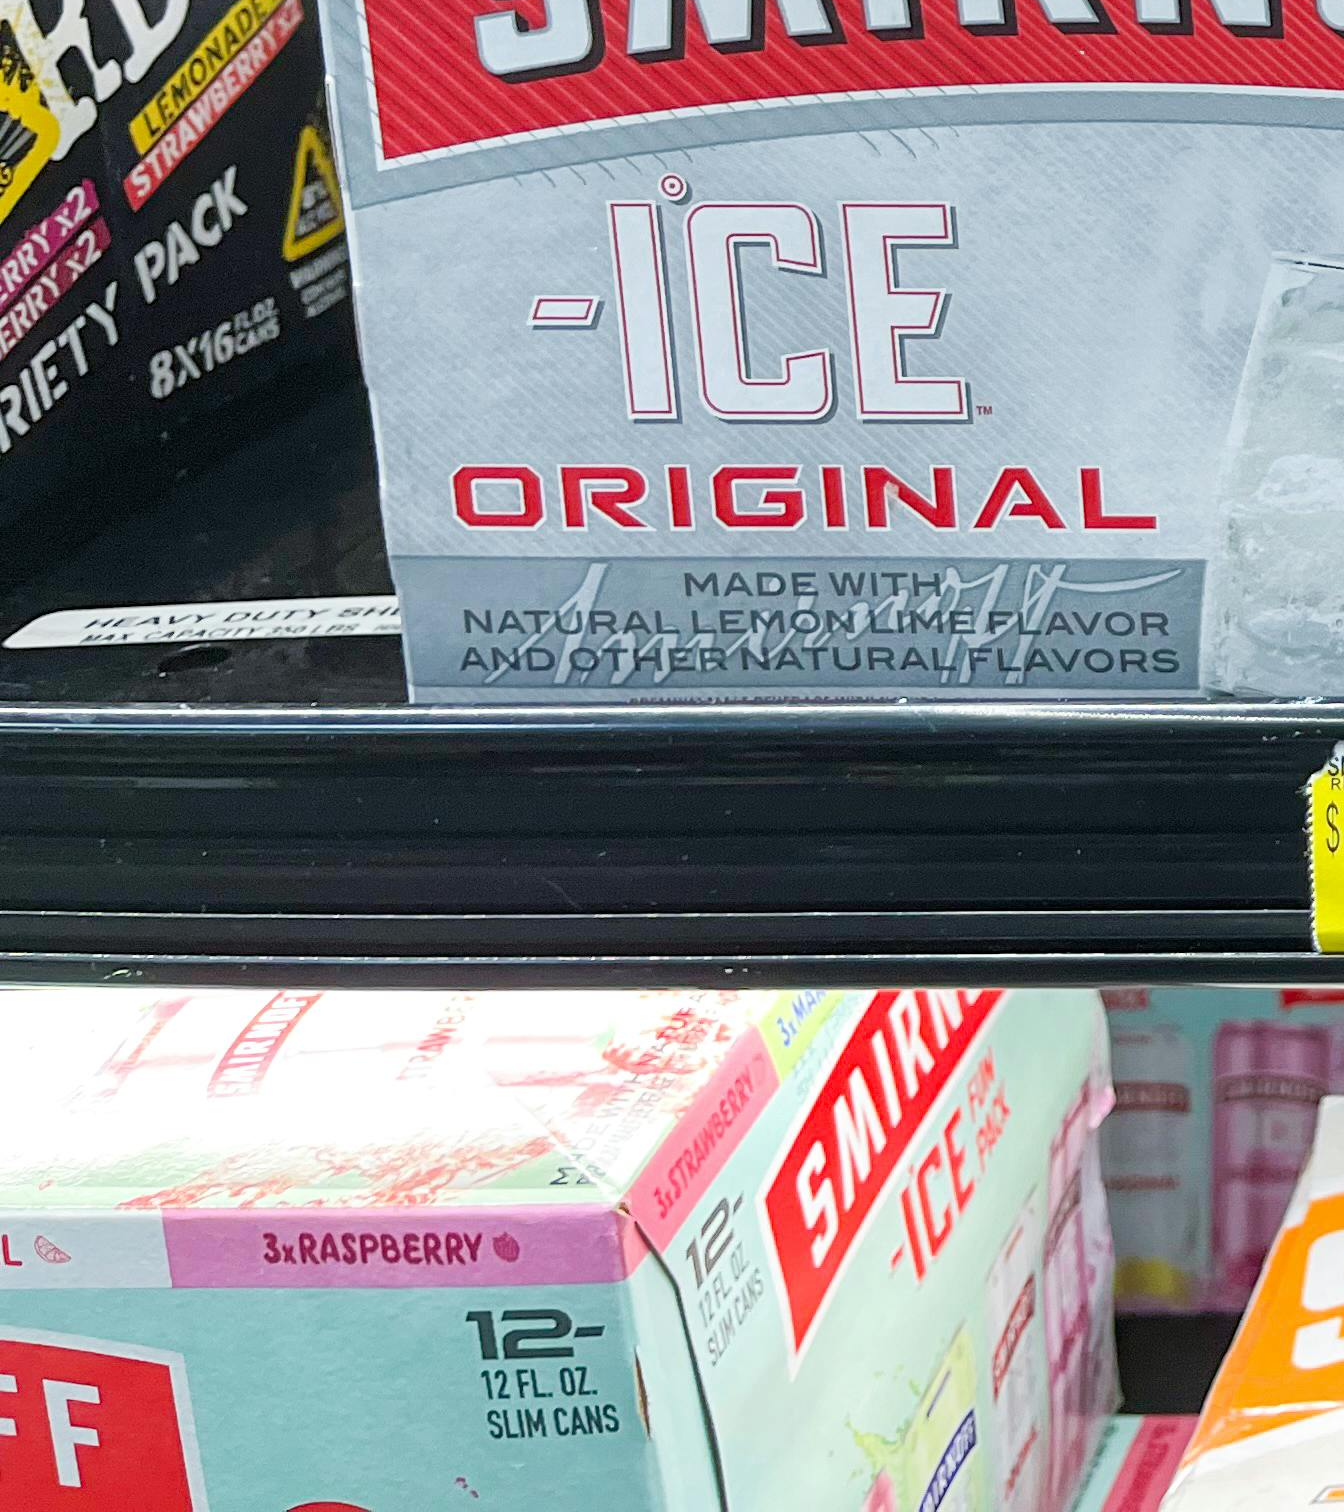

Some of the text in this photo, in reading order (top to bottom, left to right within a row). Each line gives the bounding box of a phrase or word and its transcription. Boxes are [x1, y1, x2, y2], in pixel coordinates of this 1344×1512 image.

[130, 26, 278, 199] STRAWBERRY
[56, 184, 92, 236] x2
[134, 164, 248, 305] PACK
[65, 228, 102, 282] x2
[451, 464, 1160, 533] ORIGINAL
[683, 572, 943, 598] MADE WITH
[84, 613, 216, 630] HEAVY
[223, 607, 328, 624] DUTY
[463, 609, 1171, 637] NATURAL LEMON LIME FLAVOR
[460, 646, 1182, 674] AND OTHER NATURAL FLAVORS
[699, 1291, 716, 1329] 12
[707, 1268, 765, 1367] SLIM CANS
[480, 1365, 599, 1401] 12 FL. OZ.
[486, 1403, 620, 1440] SLIM CANS
